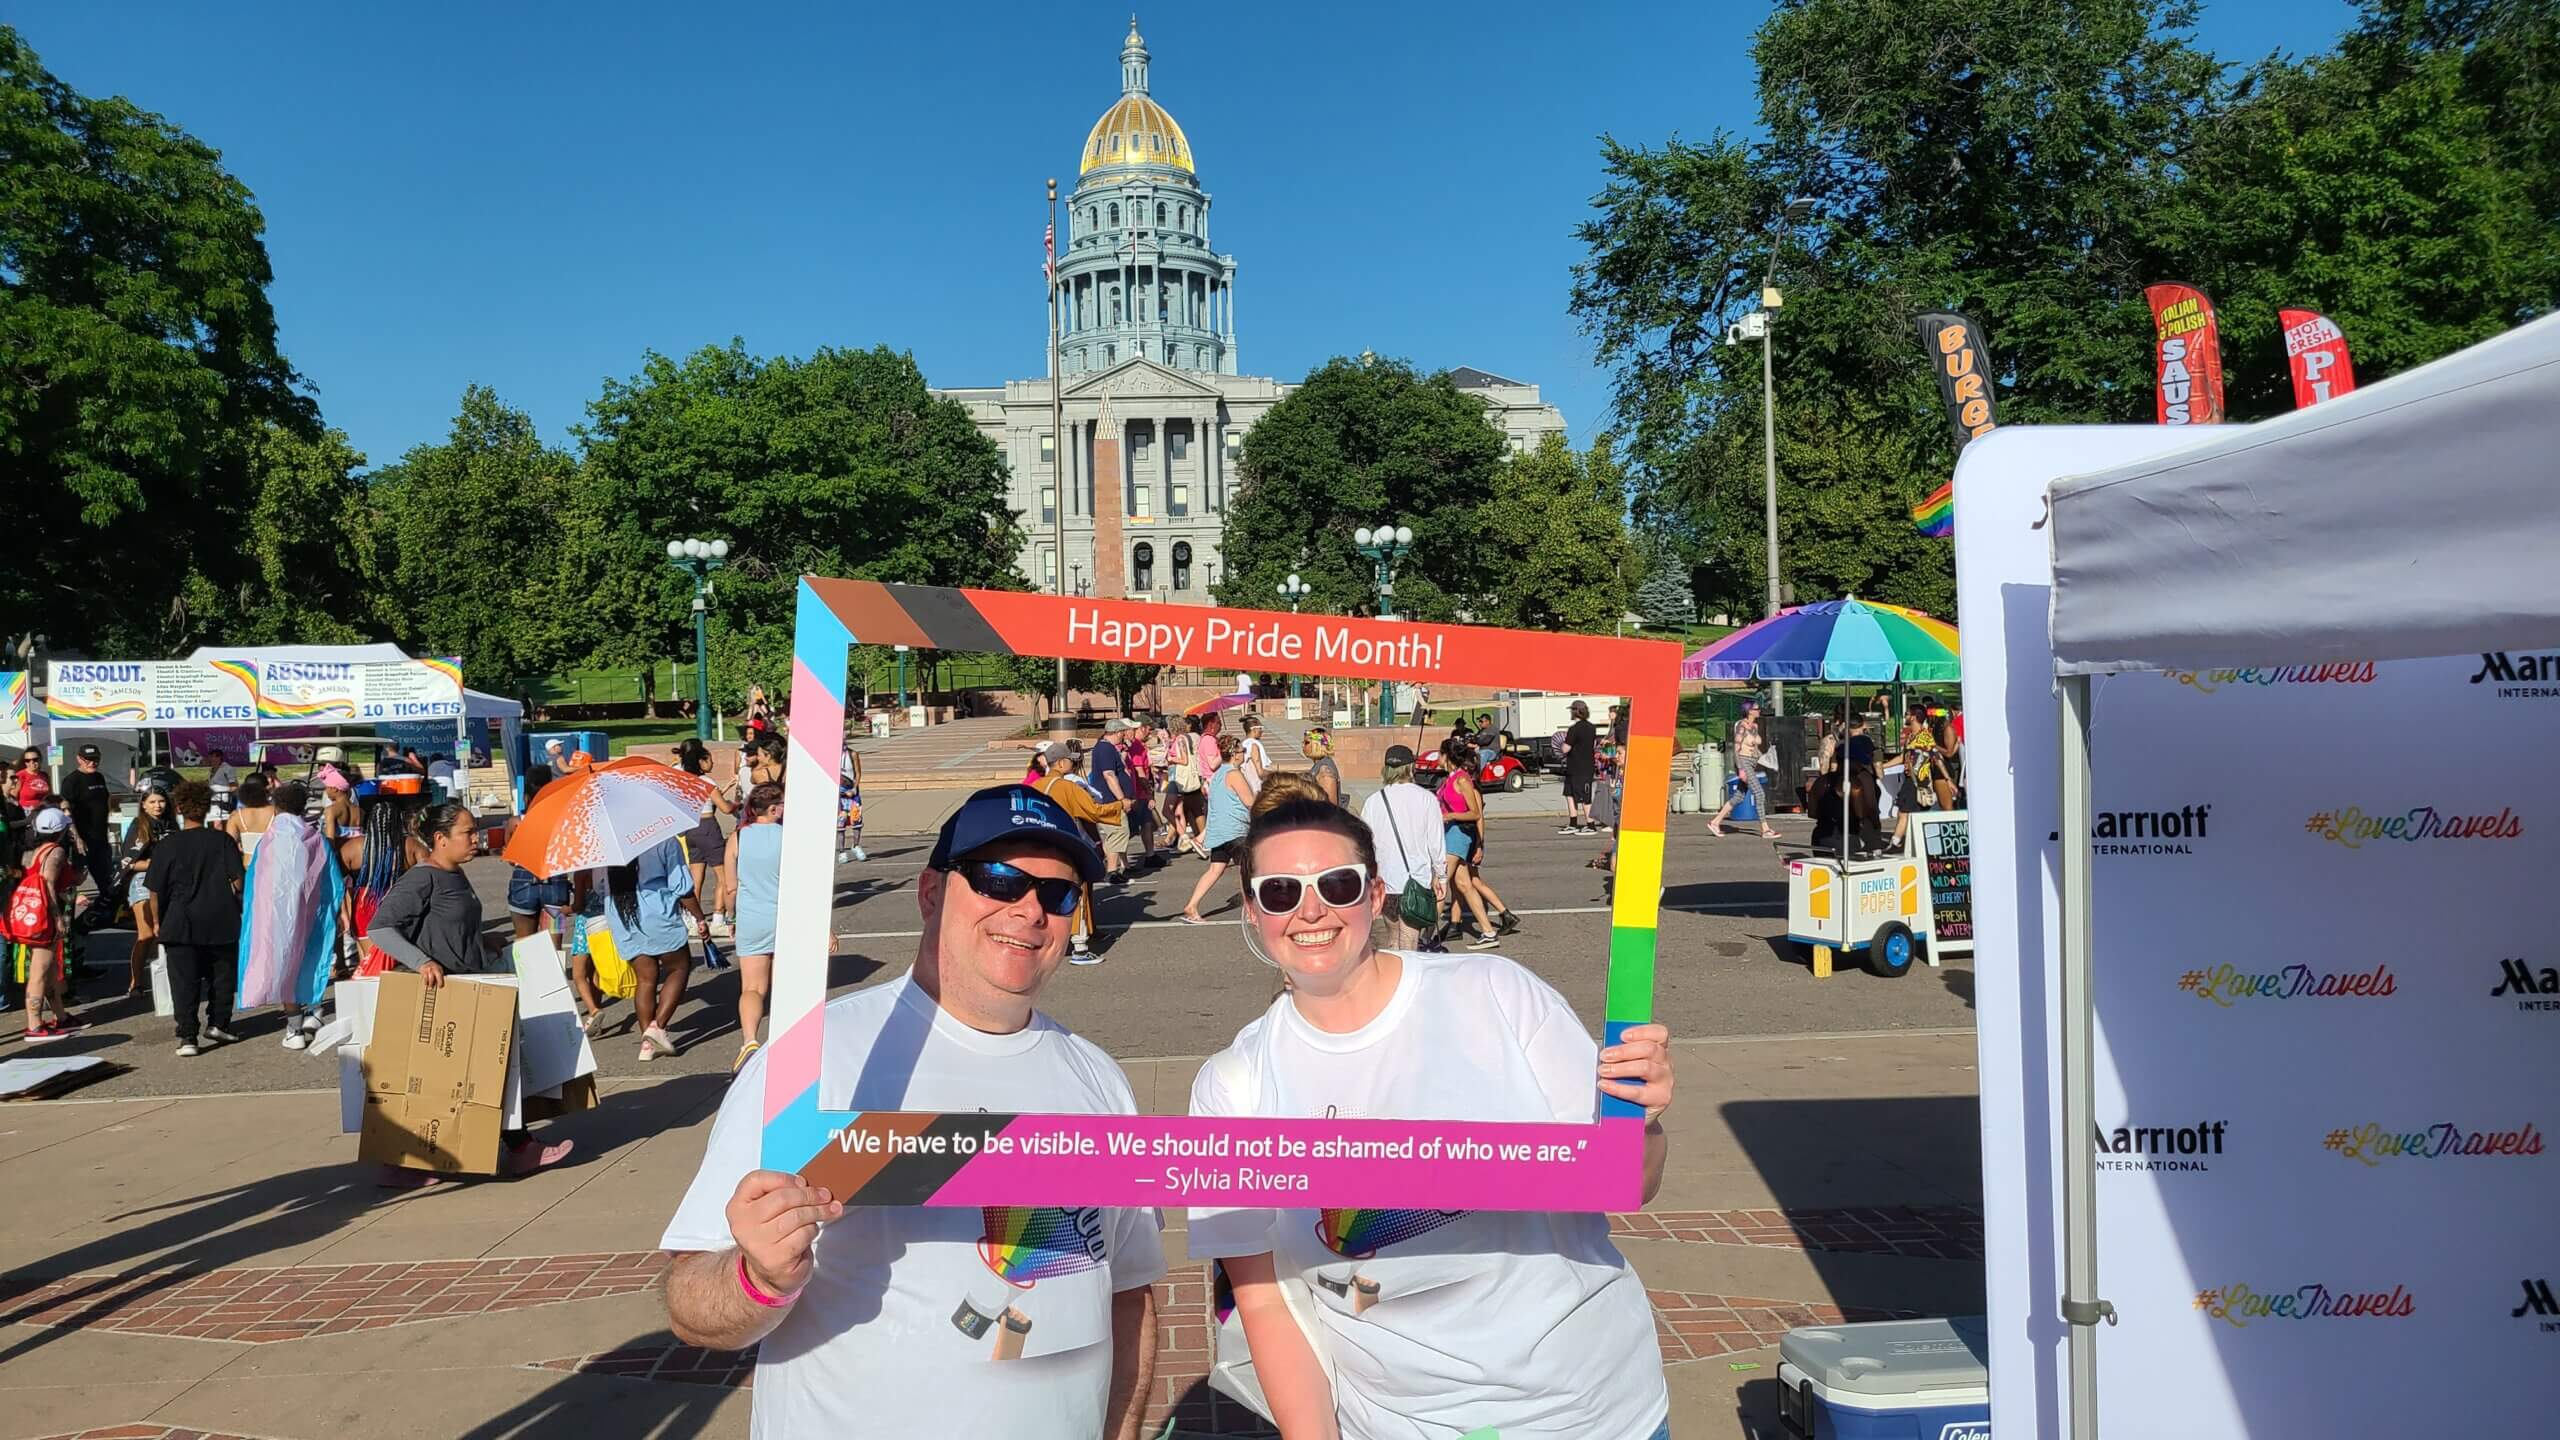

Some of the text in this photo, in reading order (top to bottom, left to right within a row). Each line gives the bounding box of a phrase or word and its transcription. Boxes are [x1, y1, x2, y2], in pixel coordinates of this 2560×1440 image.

[2160, 297, 2199, 324] ITALIAN
[2167, 311, 2207, 338] POLISH
[2289, 321, 2320, 341] HOT
[2289, 328, 2333, 354] FRESH
[1067, 607, 1444, 670] Happy Pride Month!
[111, 687, 144, 696] JAMESON
[155, 706, 251, 719] 10 TICKETS
[363, 702, 461, 717] 10 TICKETS
[390, 722, 423, 732] Rocky
[2049, 804, 2210, 841] arriott
[2305, 805, 2523, 848] #LoveTravels
[2092, 844, 2193, 855] TERNATIONAL
[1860, 877, 1895, 893] DENVER
[1860, 891, 1895, 915] POPS
[1940, 909, 1967, 922] FRESH
[2178, 962, 2398, 1008] #LoveTravels
[444, 1021, 457, 1058] Cascade
[887, 1130, 946, 1153] have
[952, 1132, 977, 1153] to
[984, 1130, 1014, 1155] be
[1020, 1131, 1100, 1156] visible.
[1107, 1132, 1147, 1156] We
[1151, 1133, 1230, 1157] should
[1235, 1136, 1273, 1158] not
[1278, 1134, 1306, 1159] be
[1312, 1136, 1413, 1160] ashamed
[1418, 1137, 1443, 1160] of
[1446, 1139, 1493, 1161] who
[1499, 1143, 1531, 1162] we
[2323, 1122, 2547, 1167] #LoveTravels
[2096, 1160, 2209, 1172] NTERNATIONAL
[1165, 1166, 1231, 1193] Sylvia
[1238, 1168, 1309, 1191] Rivera
[2192, 1283, 2416, 1328] #LoveTravels
